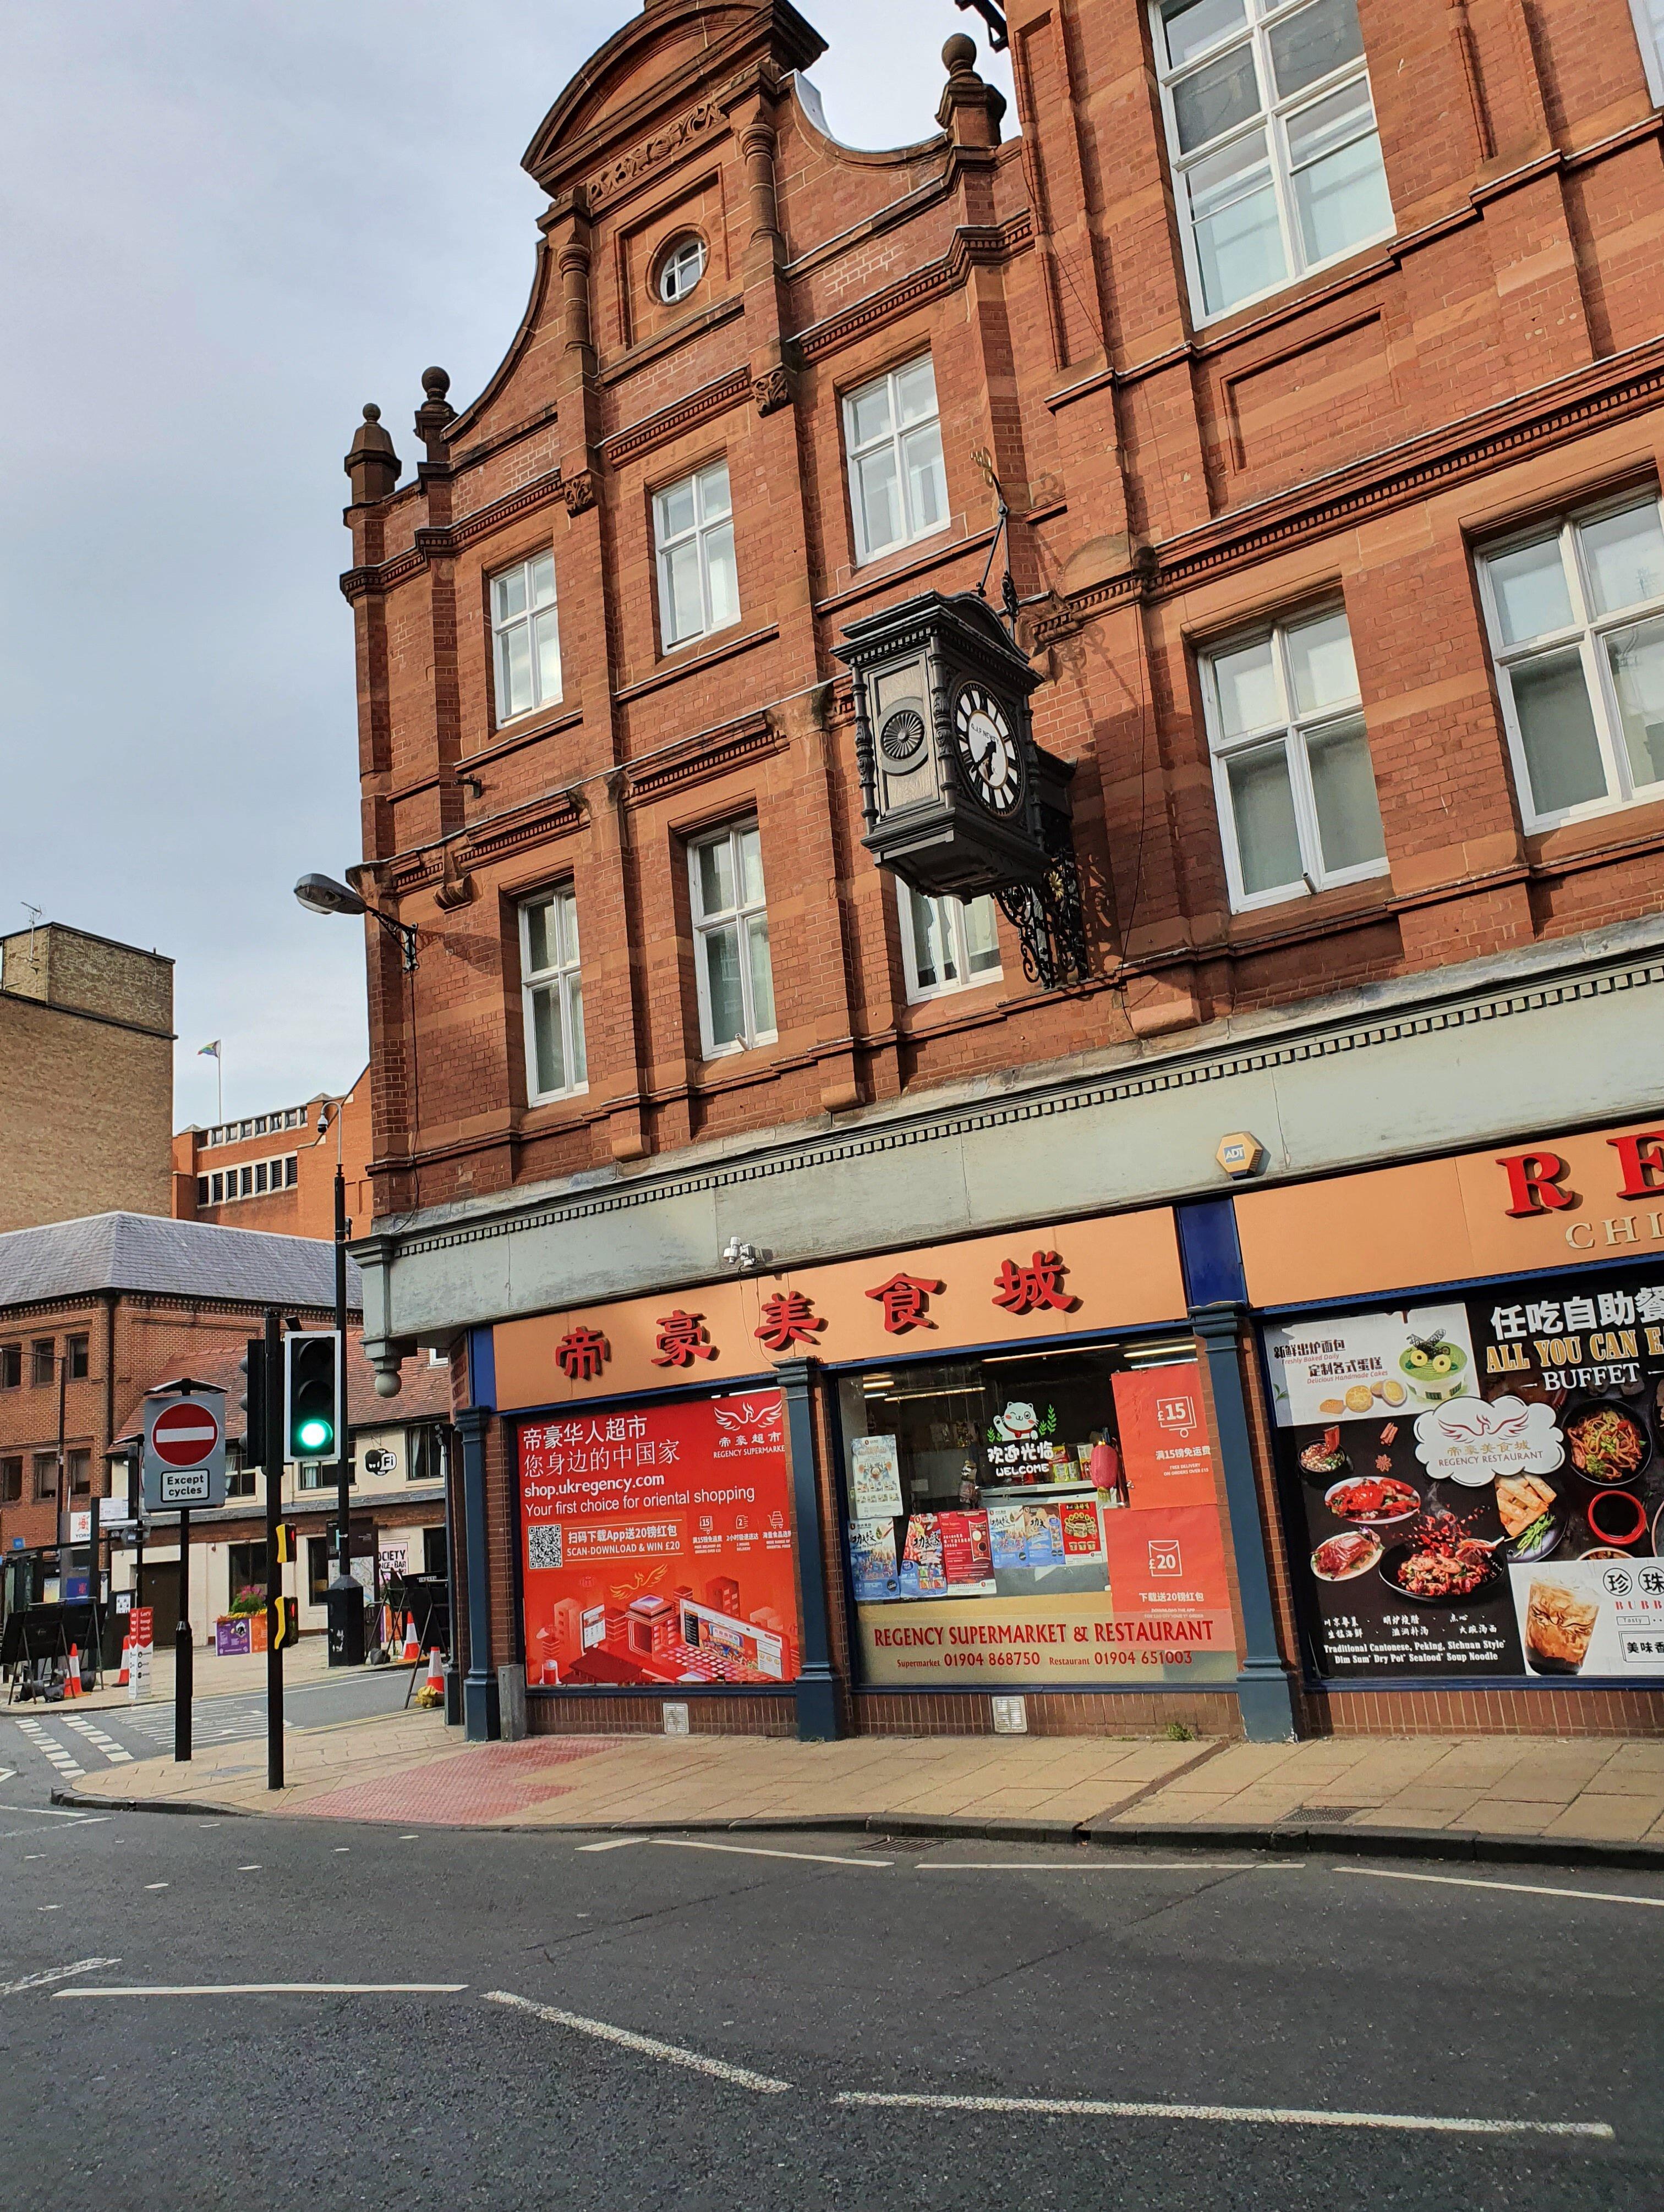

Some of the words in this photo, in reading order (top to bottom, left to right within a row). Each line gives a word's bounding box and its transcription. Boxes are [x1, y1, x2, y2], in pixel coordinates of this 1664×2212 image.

[1225, 1147, 1244, 1159] ADT
[1487, 1343, 1531, 1374] ALL
[1534, 1336, 1582, 1367] YOU
[1590, 1330, 1639, 1362] CAN
[1307, 1376, 1333, 1384] Delicious
[1335, 1373, 1369, 1381] Handmade
[1542, 1363, 1640, 1391] BUFFET
[1157, 1403, 1186, 1421] £15
[523, 1414, 647, 1451] 帝豪华人超市
[719, 1431, 781, 1447] 帝豪超市
[524, 1439, 681, 1478] 您身边的中国家
[713, 1448, 742, 1458] REGENCY
[987, 1441, 1054, 1464] 欢迎光临
[1439, 1456, 1479, 1467] REGENCY
[1482, 1451, 1543, 1463] RESTAURANT
[384, 1456, 393, 1467] Fi
[995, 1463, 1050, 1477] WELCOME
[167, 1475, 204, 1485] Except
[524, 1475, 665, 1500] shop.ukregency.com
[168, 1486, 202, 1497] cycles
[526, 1504, 552, 1517] Your
[555, 1500, 577, 1514] first
[580, 1497, 619, 1513] choice
[623, 1495, 639, 1509] for
[643, 1490, 689, 1507] oriental
[694, 1485, 754, 1505] shopping
[567, 1544, 637, 1556] SCAN-DOWNLOAD
[638, 1543, 645, 1552] &
[647, 1542, 663, 1551] WIN
[665, 1541, 680, 1550] £20
[1149, 1554, 1176, 1569] £20
[1616, 1600, 1662, 1610] BUBB
[874, 1627, 944, 1646] REGENCY
[949, 1623, 1066, 1645] SUPERMARKET
[1074, 1626, 1089, 1642] &
[1094, 1621, 1213, 1642] RESTAURANT
[1323, 1643, 1367, 1653] Traditional
[1369, 1643, 1413, 1652] Cantonese,
[1447, 1640, 1481, 1650] Sichuan
[897, 1659, 940, 1668] Supermarket
[944, 1653, 984, 1667] 01904
[989, 1651, 1040, 1666] 868750
[1049, 1656, 1090, 1665] Restaurant
[1094, 1651, 1136, 1665] 01904
[1141, 1650, 1192, 1664] 651003
[1334, 1655, 1351, 1664] Dim
[1373, 1654, 1388, 1664] Dry
[1447, 1653, 1467, 1662] Soup
[1469, 1651, 1498, 1661] Noodle
